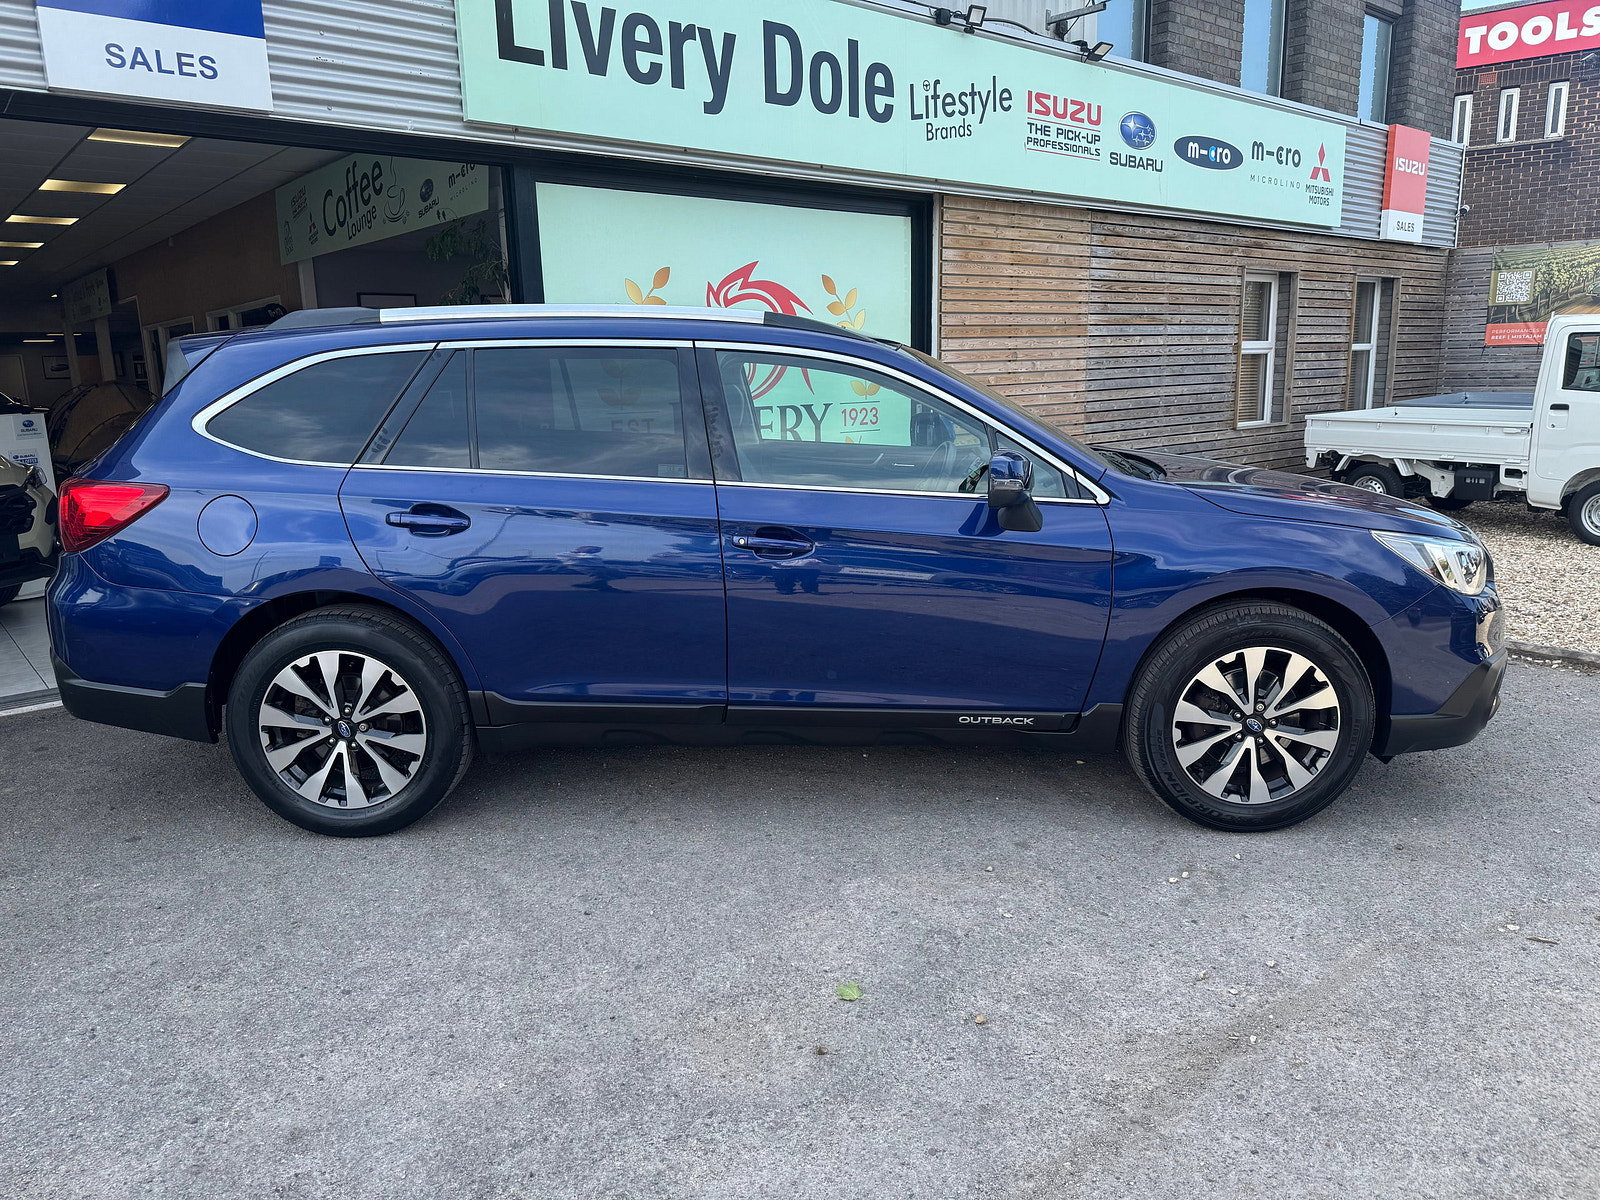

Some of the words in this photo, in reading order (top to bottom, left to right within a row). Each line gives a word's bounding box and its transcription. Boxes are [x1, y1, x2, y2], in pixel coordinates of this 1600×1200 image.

[1464, 5, 1600, 55] TOOLS
[104, 43, 218, 80] SALES
[494, 0, 736, 115] Livery
[762, 20, 895, 123] Dole
[909, 75, 1013, 125] Lifestyle
[1027, 90, 1102, 126] ISUZU
[926, 118, 972, 142] Brands
[1027, 122, 1051, 137] THE
[1056, 127, 1101, 146] PICK-UP
[1026, 136, 1101, 157] PROFESSIONALS
[1109, 151, 1164, 173] SUBARU
[1395, 156, 1426, 176] ISUZU
[1250, 174, 1302, 190] MICROLINO
[1305, 184, 1335, 196] MITSUBISHI
[322, 160, 384, 236] Coffee
[417, 195, 440, 219] SUBARU
[1308, 195, 1331, 206] MOTORS
[346, 205, 378, 240] Lounge
[1396, 220, 1415, 233] SALES
[841, 406, 879, 427] 1923
[958, 715, 1035, 725] OUTBACK
